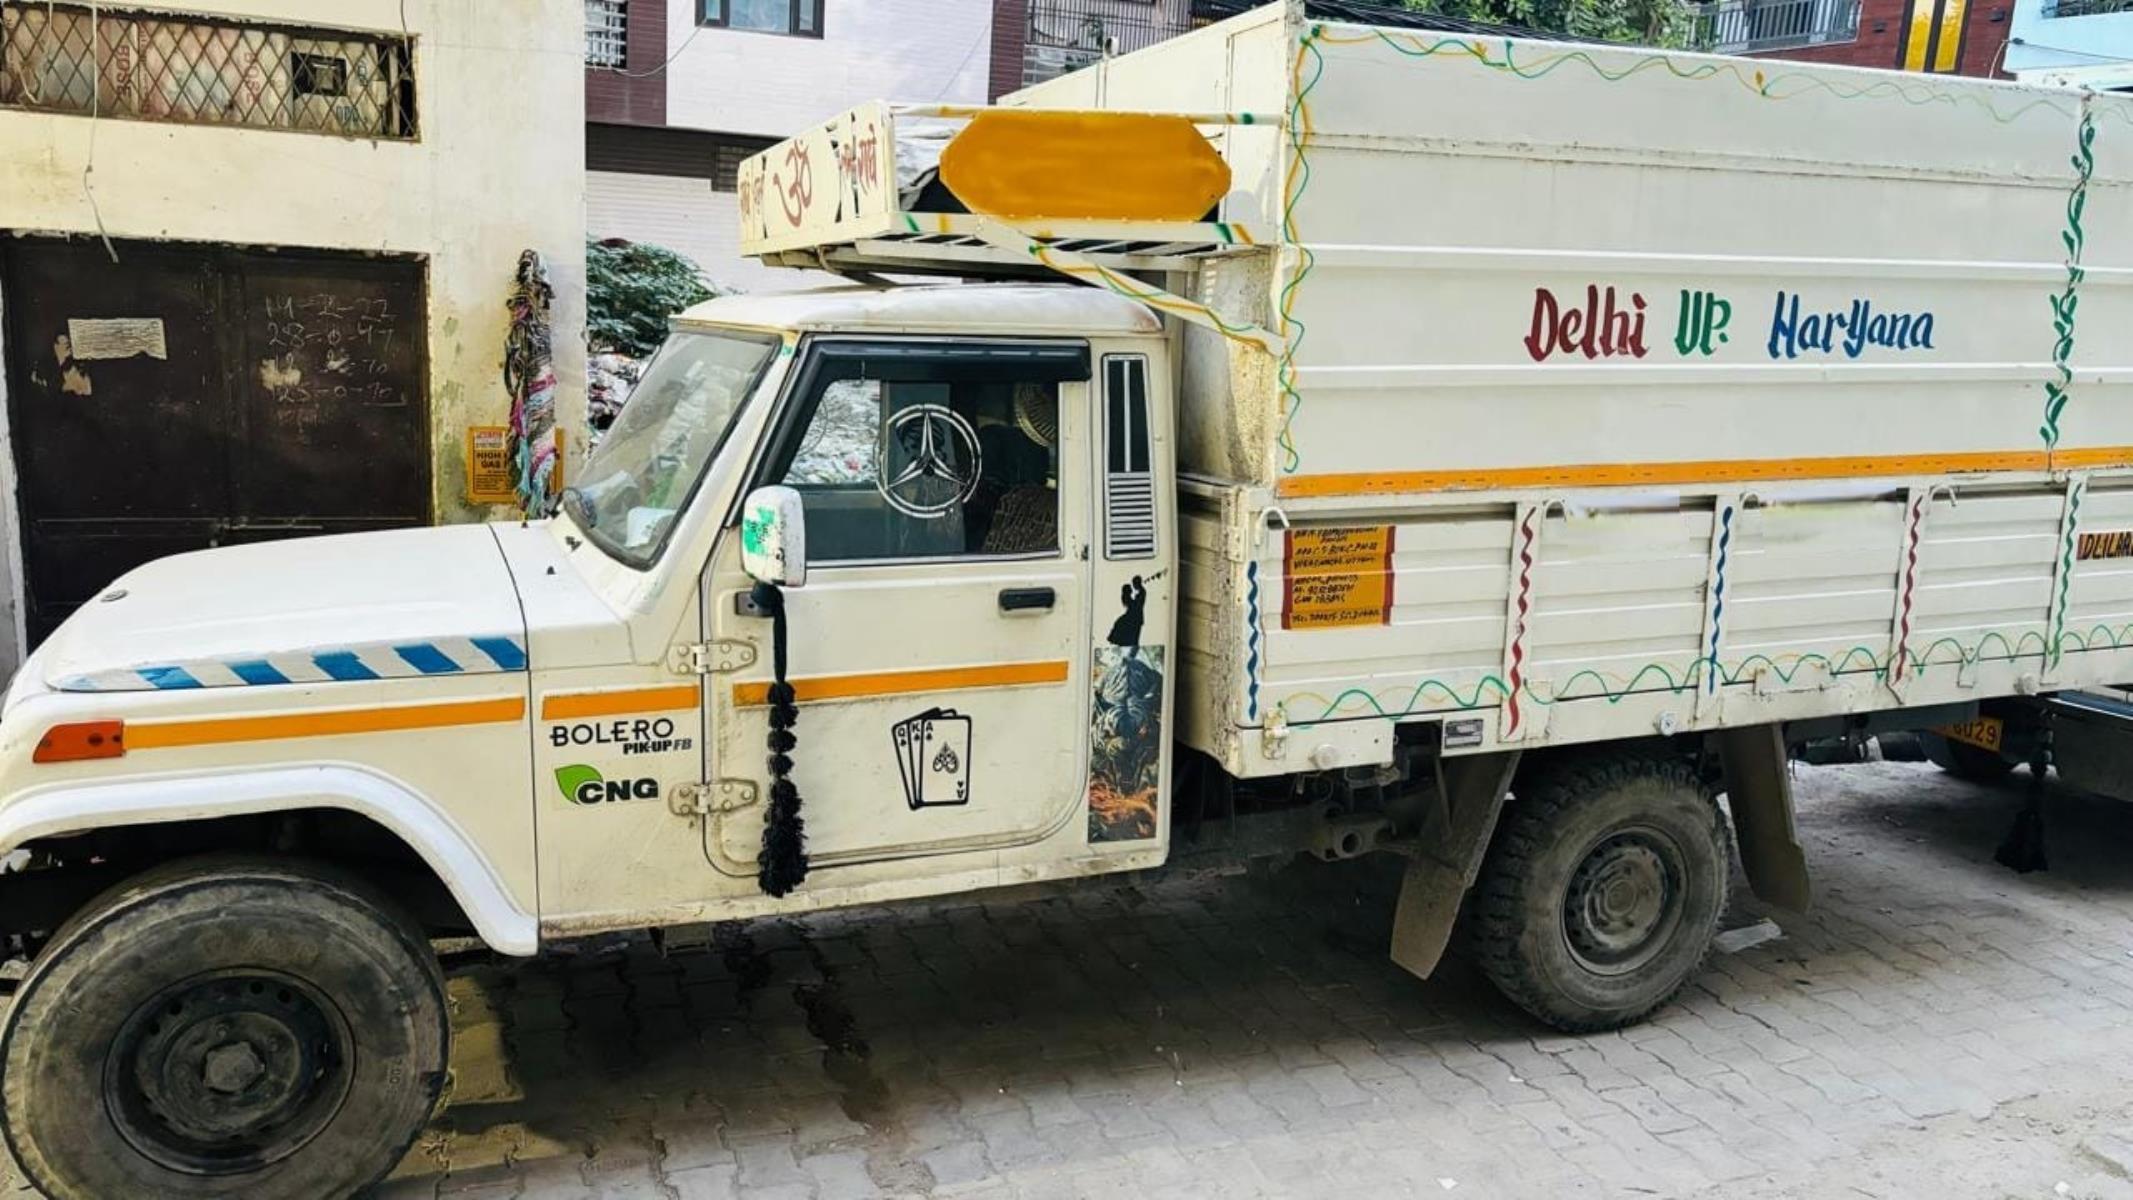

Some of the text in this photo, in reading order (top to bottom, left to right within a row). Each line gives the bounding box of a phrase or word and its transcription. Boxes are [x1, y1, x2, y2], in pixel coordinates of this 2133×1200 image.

[1523, 283, 1649, 362] Delhi
[549, 718, 675, 747] BOLERO
[912, 722, 921, 733] K
[926, 721, 934, 732] A
[672, 737, 692, 752] FB
[577, 777, 659, 804] CNG
